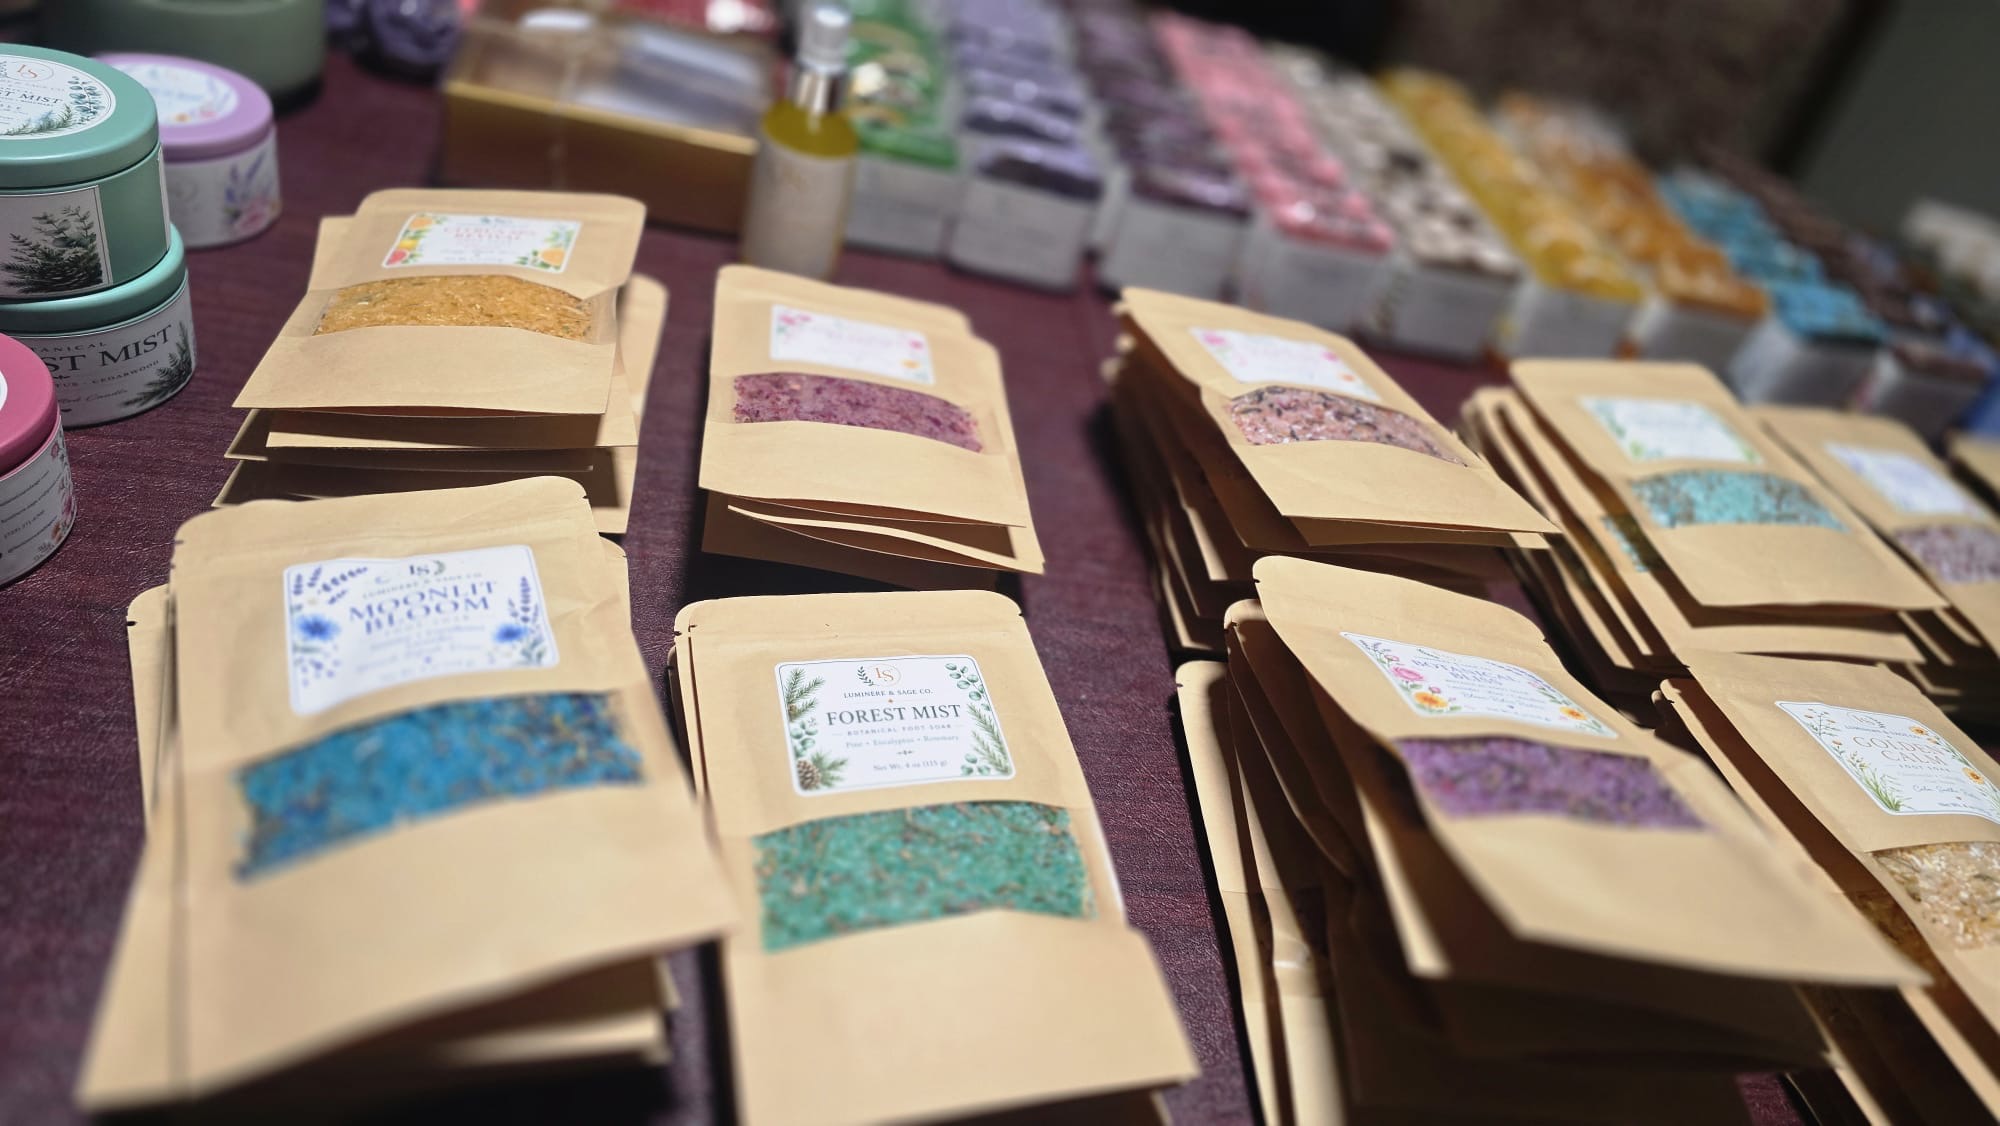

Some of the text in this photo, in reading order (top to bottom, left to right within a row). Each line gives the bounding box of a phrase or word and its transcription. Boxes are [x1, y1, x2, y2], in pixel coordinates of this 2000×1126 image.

[18, 93, 63, 104] MIST
[98, 329, 172, 367] MIST
[349, 581, 497, 621] MOONLIT
[364, 596, 489, 635] BLOOM
[843, 690, 886, 699] LUMINERE
[897, 688, 917, 696] SAGE
[826, 704, 961, 726] FOREST MIST
[847, 727, 898, 736] BOTANICAL
[929, 723, 952, 731] SOAK
[1853, 736, 1945, 755] GOLDEN
[1881, 750, 1948, 766] CALM
